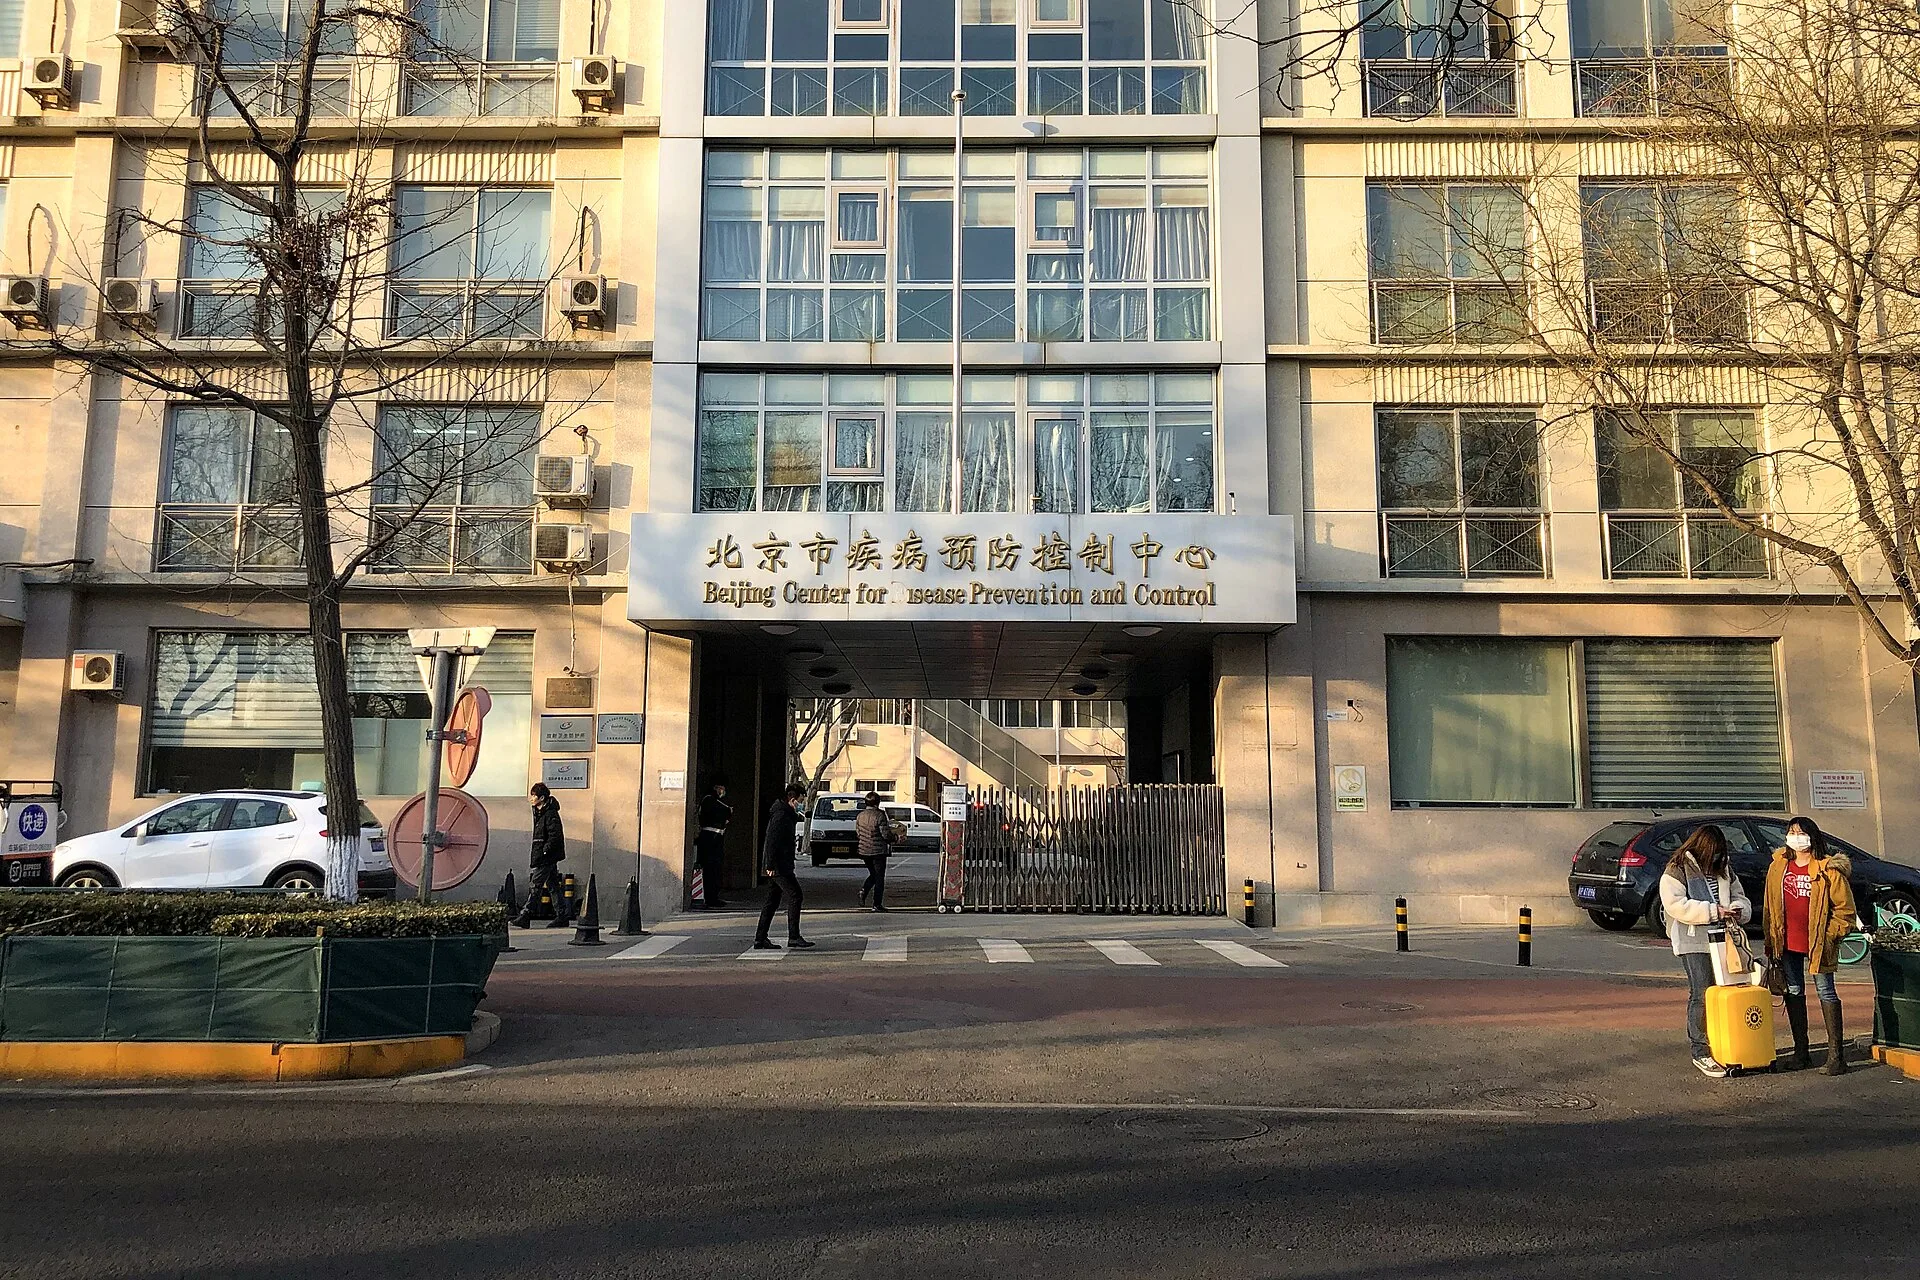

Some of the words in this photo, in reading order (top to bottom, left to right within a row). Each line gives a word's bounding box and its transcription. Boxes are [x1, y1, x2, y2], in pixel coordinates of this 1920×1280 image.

[705, 530, 1216, 577] 北京市疾病预防控制中心
[704, 581, 776, 608] Beijing
[782, 580, 850, 604] Center
[856, 582, 888, 605] for
[969, 581, 1084, 606] Prevention
[1090, 581, 1127, 606] and
[1134, 581, 1216, 606] Control
